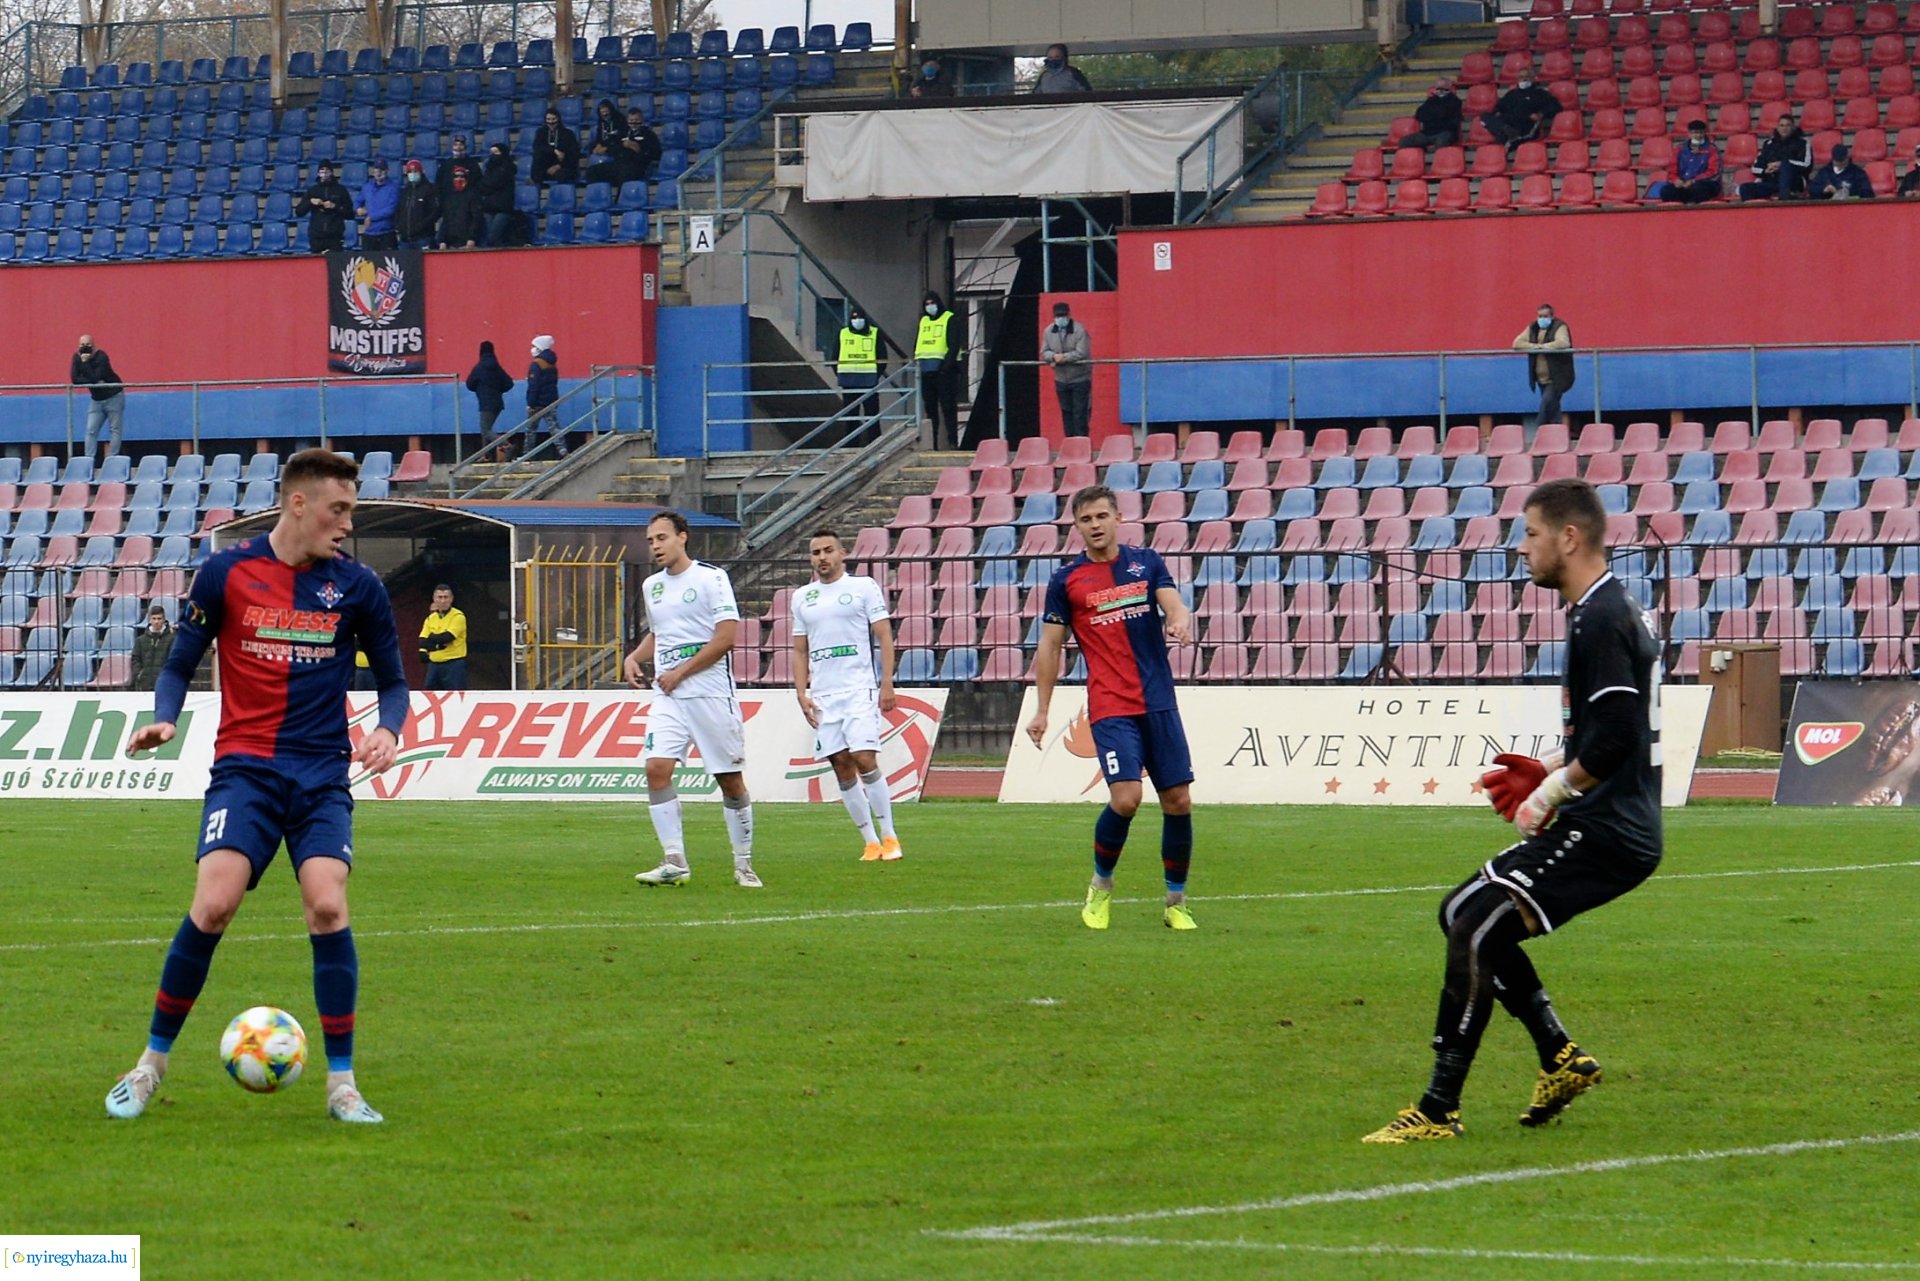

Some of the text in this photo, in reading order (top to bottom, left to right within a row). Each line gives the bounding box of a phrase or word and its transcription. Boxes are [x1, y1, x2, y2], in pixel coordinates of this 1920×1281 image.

[696, 230, 710, 249] A
[389, 281, 400, 295] S
[330, 325, 423, 355] MASTIFFS
[1358, 700, 1492, 715] HOTEL
[1803, 727, 1842, 744] MOL
[1224, 726, 1565, 767] AVENTIN
[1105, 751, 1120, 775] 6
[1, 767, 174, 792] gó Szövetség
[485, 773, 556, 788] ALWAYS
[557, 774, 583, 787] ON
[585, 774, 620, 787] THE
[678, 774, 717, 788] WAY
[204, 808, 229, 845] 21
